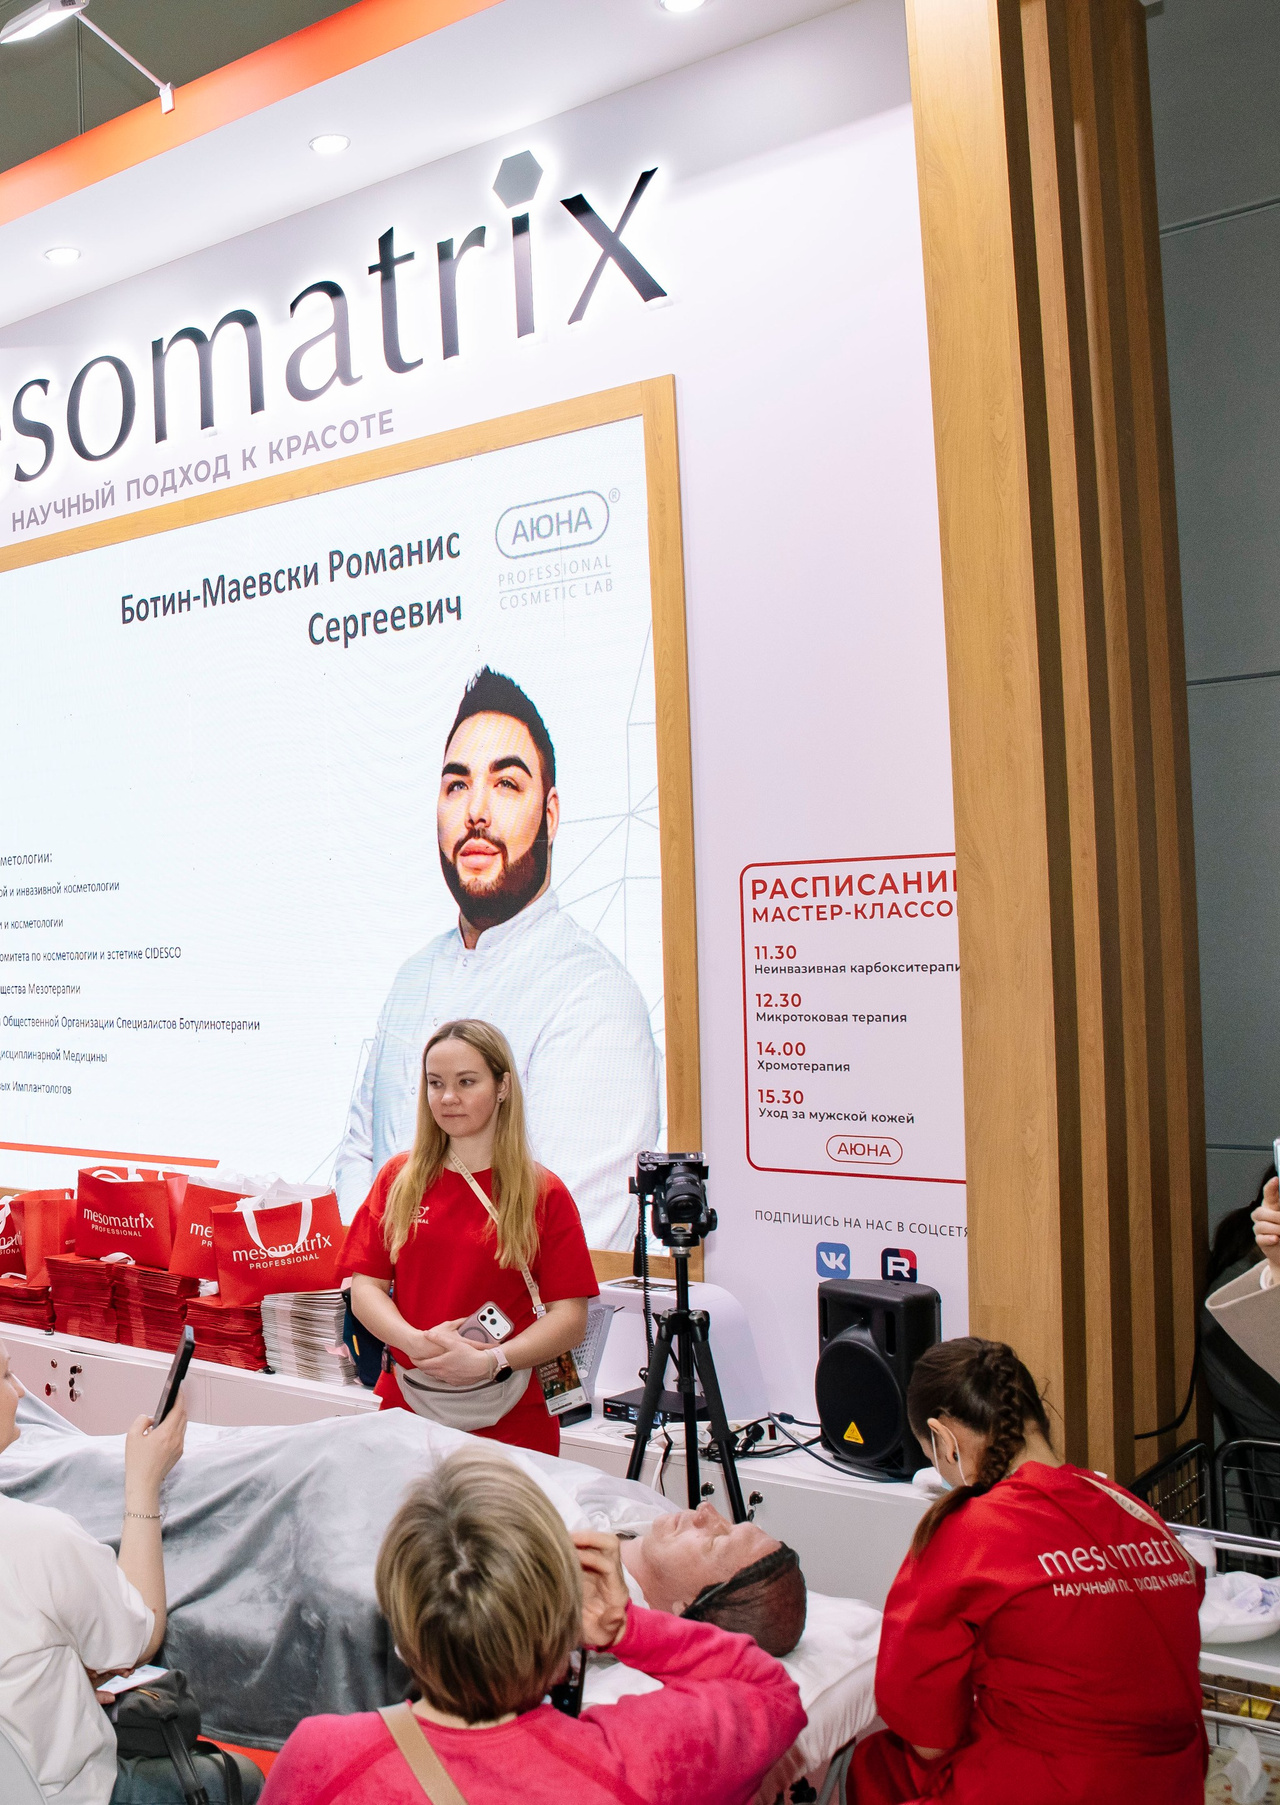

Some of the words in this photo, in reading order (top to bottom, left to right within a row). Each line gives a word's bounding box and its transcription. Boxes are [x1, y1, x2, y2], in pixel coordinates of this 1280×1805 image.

[11, 480, 116, 532] НАУЧНЫЙ
[126, 453, 231, 502] ПОДХОД
[242, 446, 258, 471] К
[268, 408, 395, 464] КРАСОТЕ
[512, 506, 593, 545] АЮНА
[121, 561, 320, 624] Ботин-Маевски
[328, 532, 462, 583] Романис
[498, 555, 612, 587] PROFESSIONAL
[499, 584, 577, 610] COSMETIC
[584, 578, 613, 596] LAB
[308, 595, 463, 649] Сергеевич
[10, 887, 15, 897] и
[16, 882, 62, 896] инвазивной
[63, 881, 120, 894] косметологии
[752, 900, 954, 923] МАСТЕР-КЛАССО
[4, 920, 9, 929] и
[10, 918, 64, 930] косметологии
[31, 952, 42, 962] по
[43, 950, 98, 961] косметологии
[100, 950, 105, 960] и
[107, 949, 143, 960] эстетике
[144, 946, 182, 959] CIDESCO
[754, 945, 797, 960] 11.30
[754, 962, 847, 975] Неинвазивная
[850, 961, 960, 976] карбокситерапи
[28, 983, 81, 997] Мезотерапии
[756, 993, 802, 1008] 12.30
[2, 1014, 60, 1029] Общественной
[61, 1016, 115, 1031] Организации
[116, 1017, 177, 1031] Специалистов
[179, 1017, 260, 1033] Ботулинотерапии
[756, 1012, 849, 1024] Микротоковая
[852, 1012, 907, 1025] терапия
[62, 1050, 108, 1063] Медицины
[757, 1041, 806, 1056] 14.00
[757, 1060, 851, 1074] Хромотерапия
[12, 1081, 72, 1095] Имплантологов
[758, 1089, 804, 1105] 15.30
[758, 1107, 789, 1120] Уход
[792, 1110, 805, 1119] за
[809, 1110, 867, 1123] мужской
[871, 1111, 915, 1124] кожей
[837, 1142, 892, 1158] АЮНА
[83, 1208, 155, 1229] mesomatrix
[755, 1210, 839, 1227] ПОДПИШИСЬ
[843, 1217, 862, 1229] НА
[866, 1219, 893, 1232] НАС
[897, 1221, 905, 1232] В
[909, 1222, 968, 1238] СОЦСЕТЯ
[91, 1223, 142, 1237] PROFESSIONAL
[232, 1232, 333, 1262] mesomatrix
[249, 1253, 320, 1270] PROFESSIONAL
[1053, 1577, 1117, 1597] НАУЧНЫЙ
[1120, 1576, 1162, 1592] ПХОД
